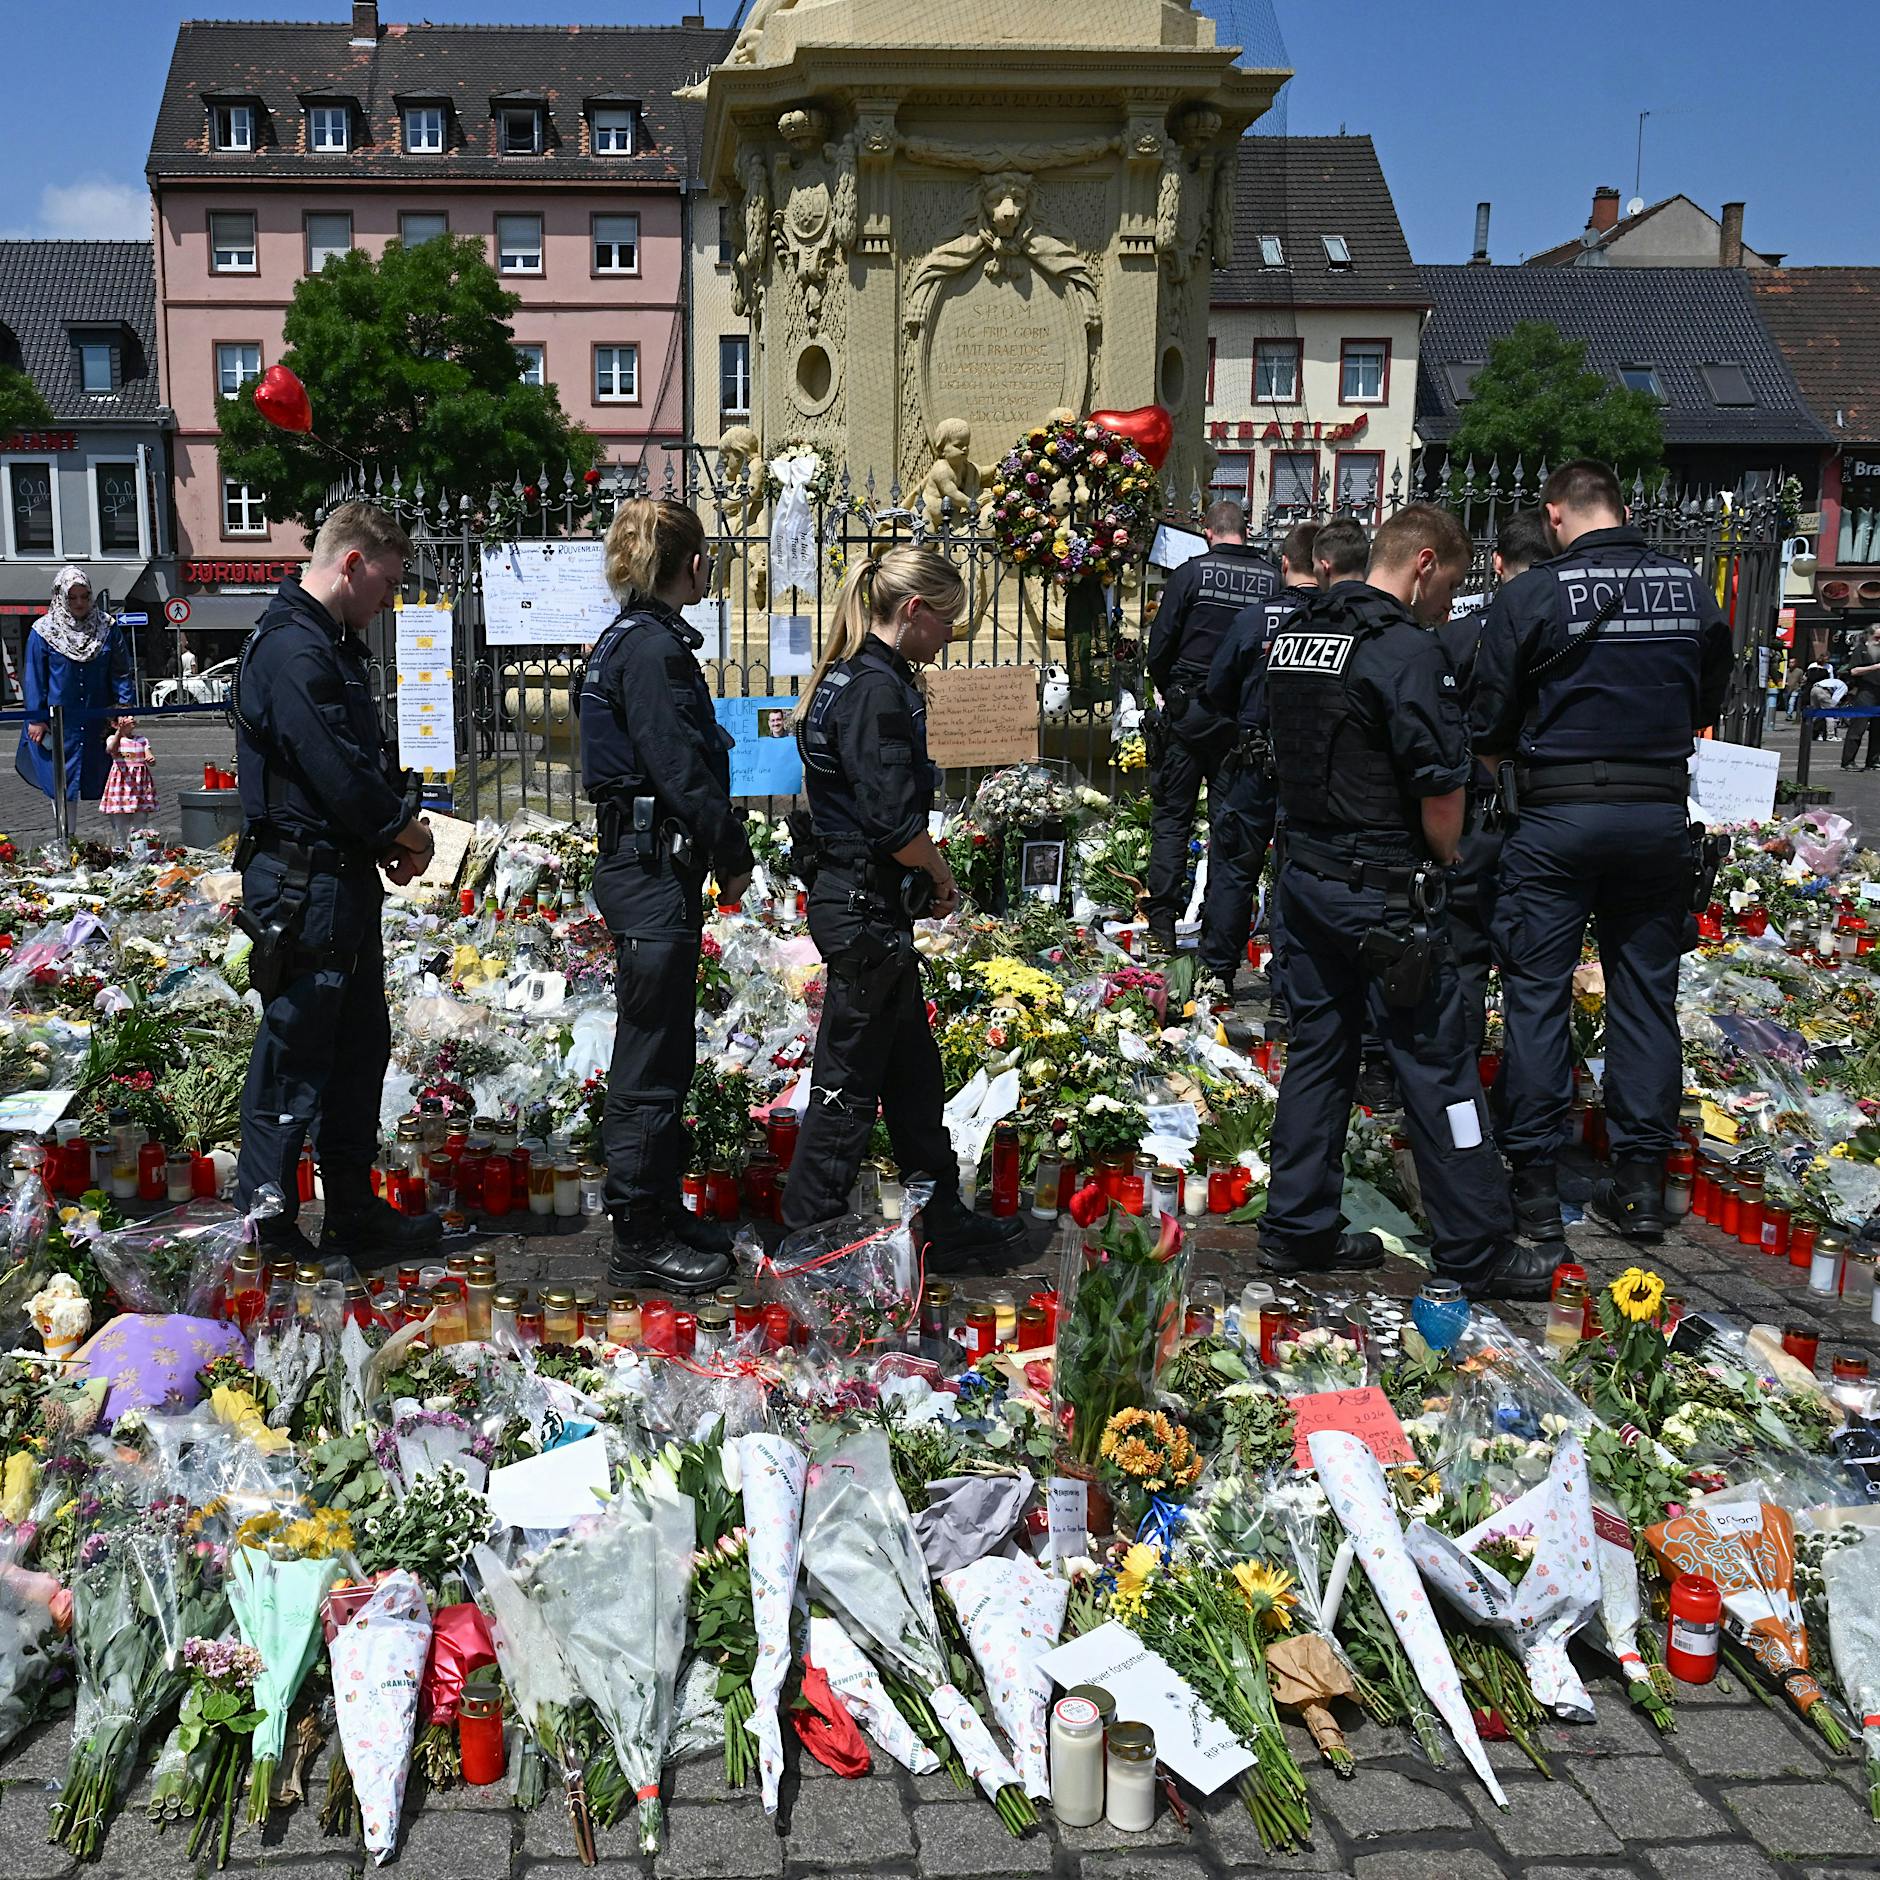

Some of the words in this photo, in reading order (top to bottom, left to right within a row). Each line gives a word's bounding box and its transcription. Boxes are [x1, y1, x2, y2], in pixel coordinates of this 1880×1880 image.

[1202, 569, 1273, 596] POLIZEI
[1568, 582, 1697, 616] POLIZEI
[1268, 637, 1348, 668] POLIZEI
[970, 1596, 991, 1622] BLUMEN
[1083, 1669, 1111, 1687] Never
[1107, 1651, 1149, 1675] forgotten
[1203, 1745, 1221, 1760] RIP
